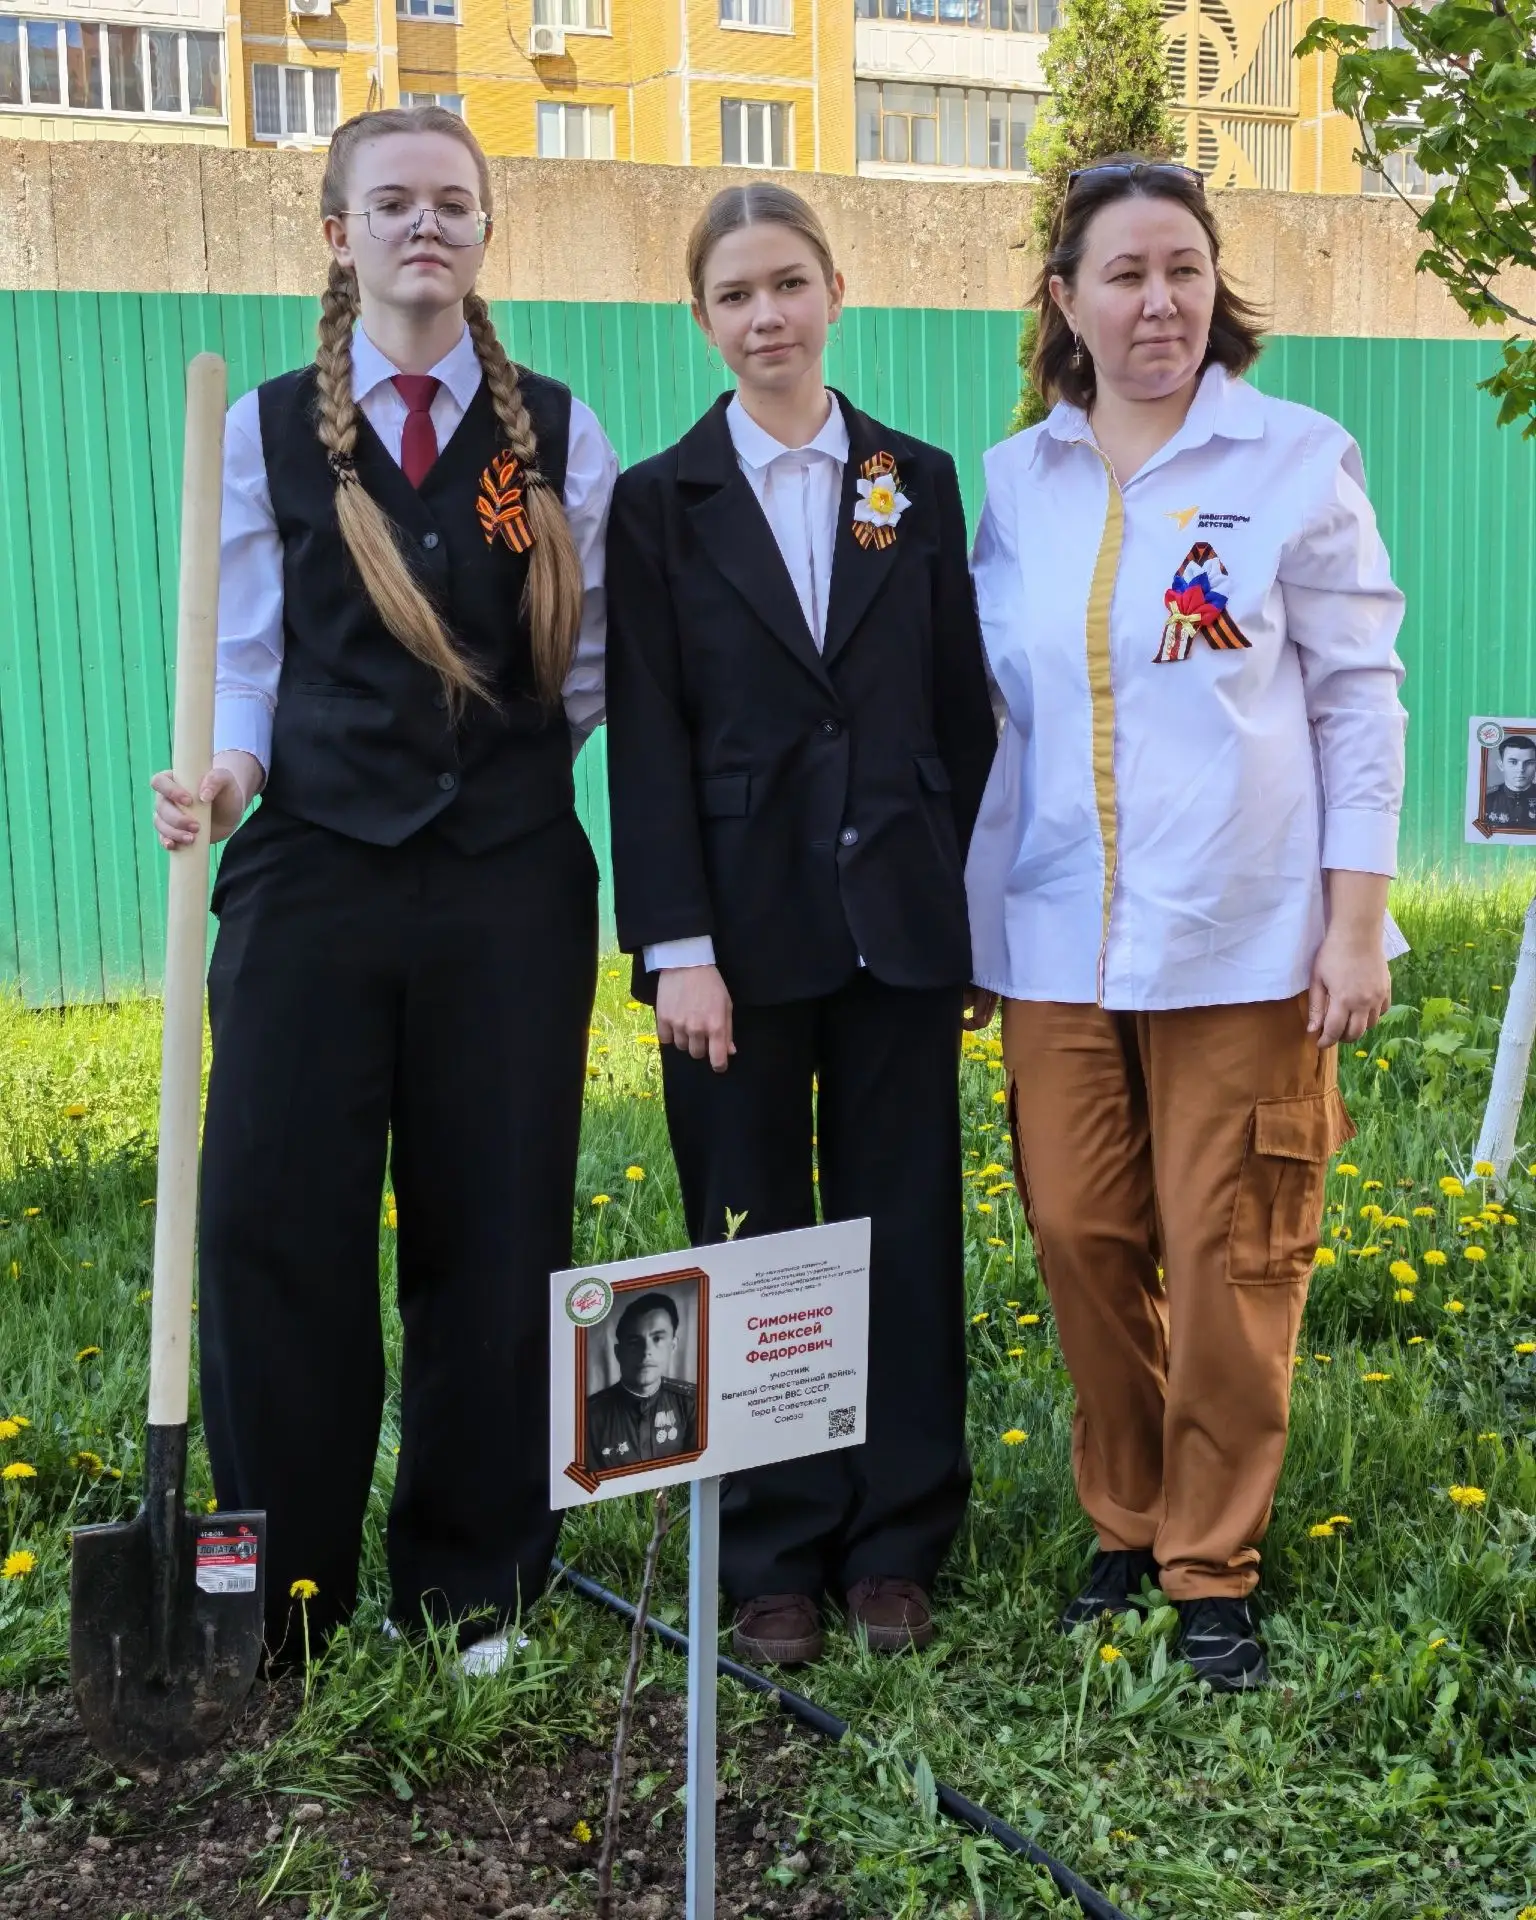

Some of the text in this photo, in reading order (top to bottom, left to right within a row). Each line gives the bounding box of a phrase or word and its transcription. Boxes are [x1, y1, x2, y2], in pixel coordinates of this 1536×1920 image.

[747, 1305, 833, 1330] Симоненко
[758, 1322, 822, 1345] Алексей
[745, 1338, 833, 1363] Федорович
[769, 1366, 810, 1381] участник
[721, 1387, 758, 1401] Великой
[759, 1373, 826, 1393] Отечественной
[747, 1392, 783, 1407] капитан
[785, 1388, 803, 1399] ВВС
[751, 1396, 827, 1417] Герой Советского
[774, 1412, 804, 1424] Союза
